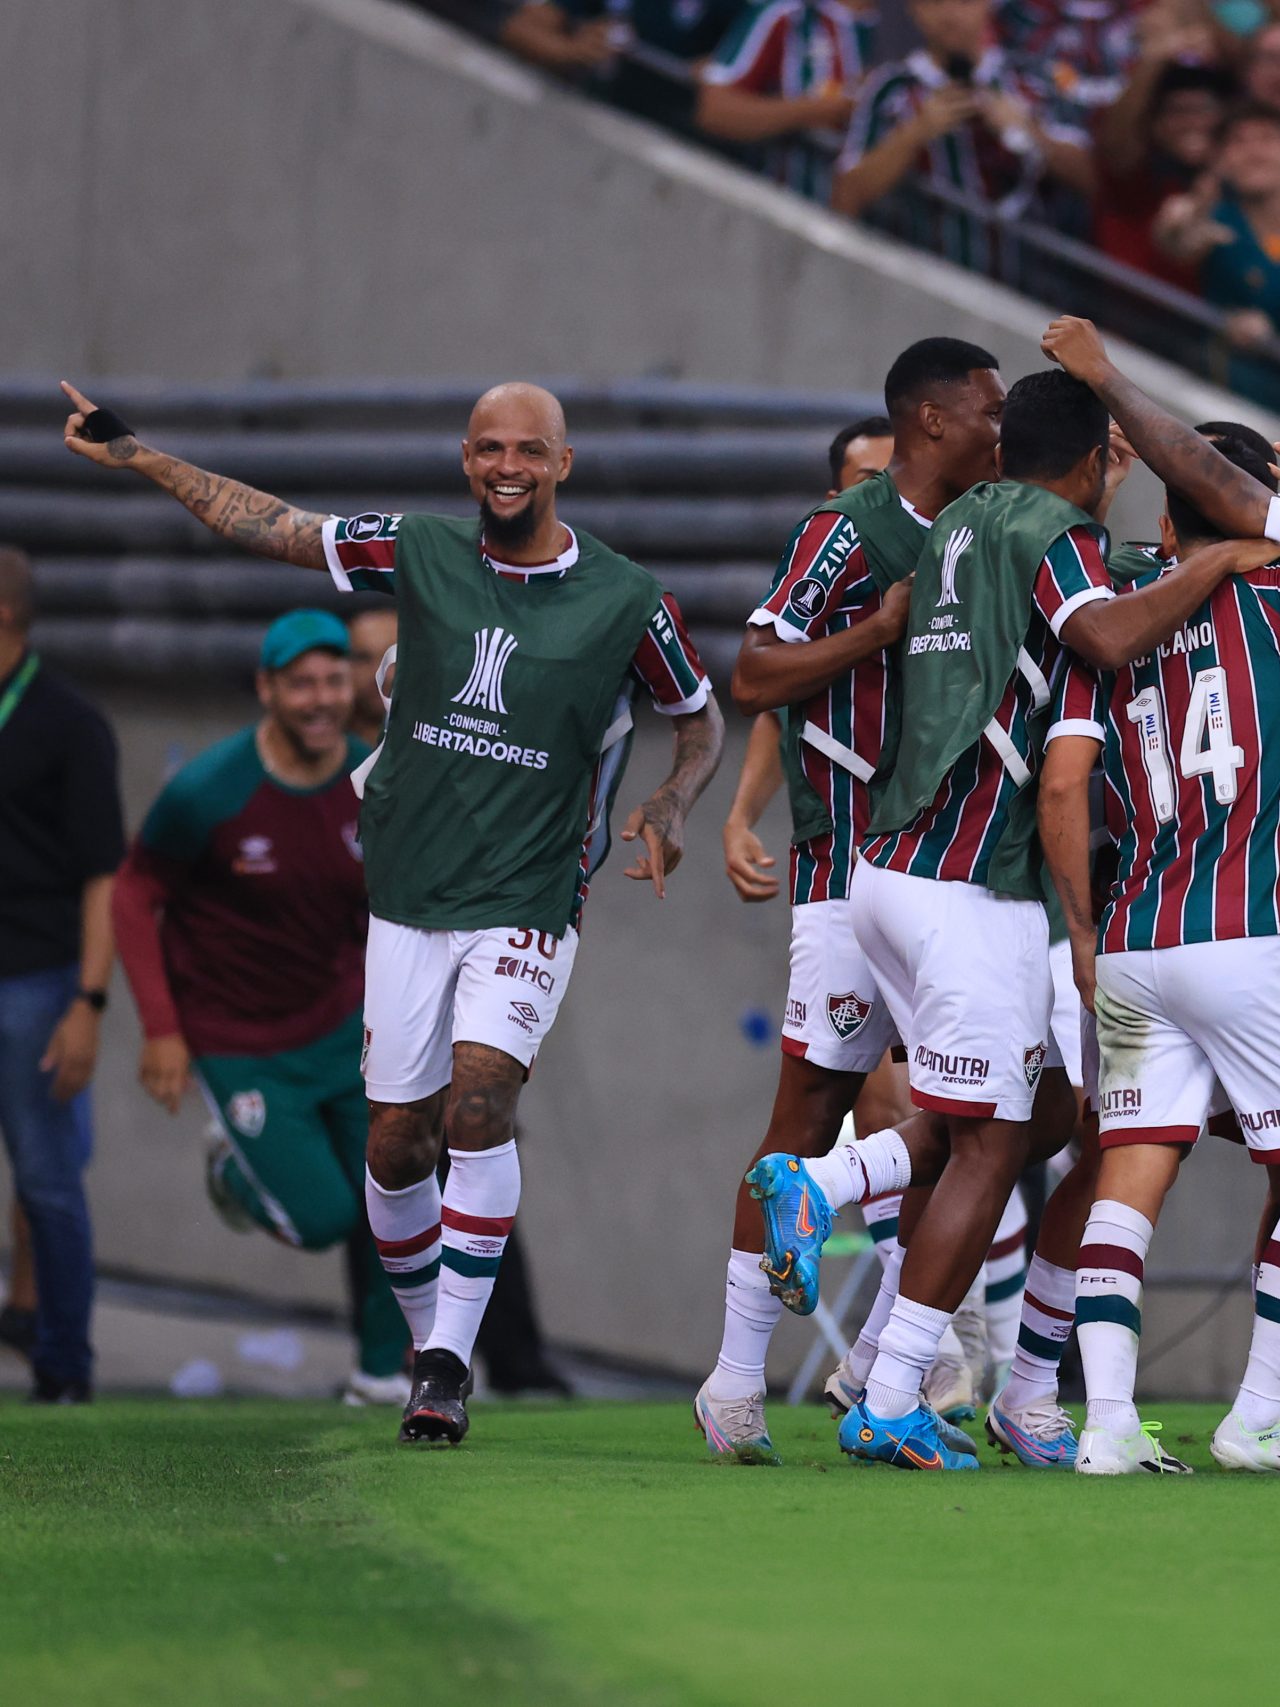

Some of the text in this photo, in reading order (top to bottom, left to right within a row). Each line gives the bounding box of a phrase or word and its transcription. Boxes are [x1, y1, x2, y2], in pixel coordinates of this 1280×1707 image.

[1160, 621, 1213, 658] CANO
[1209, 692, 1220, 717] TIM
[1146, 713, 1156, 738] TIM
[412, 720, 549, 770] LIBERTADORES
[1126, 666, 1245, 825] 14
[520, 960, 555, 995] HCI
[507, 1013, 533, 1034] umbro
[942, 1076, 986, 1086] RECOVERY
[1103, 1108, 1141, 1120] RECOVERY
[1080, 1276, 1117, 1284] FFC
